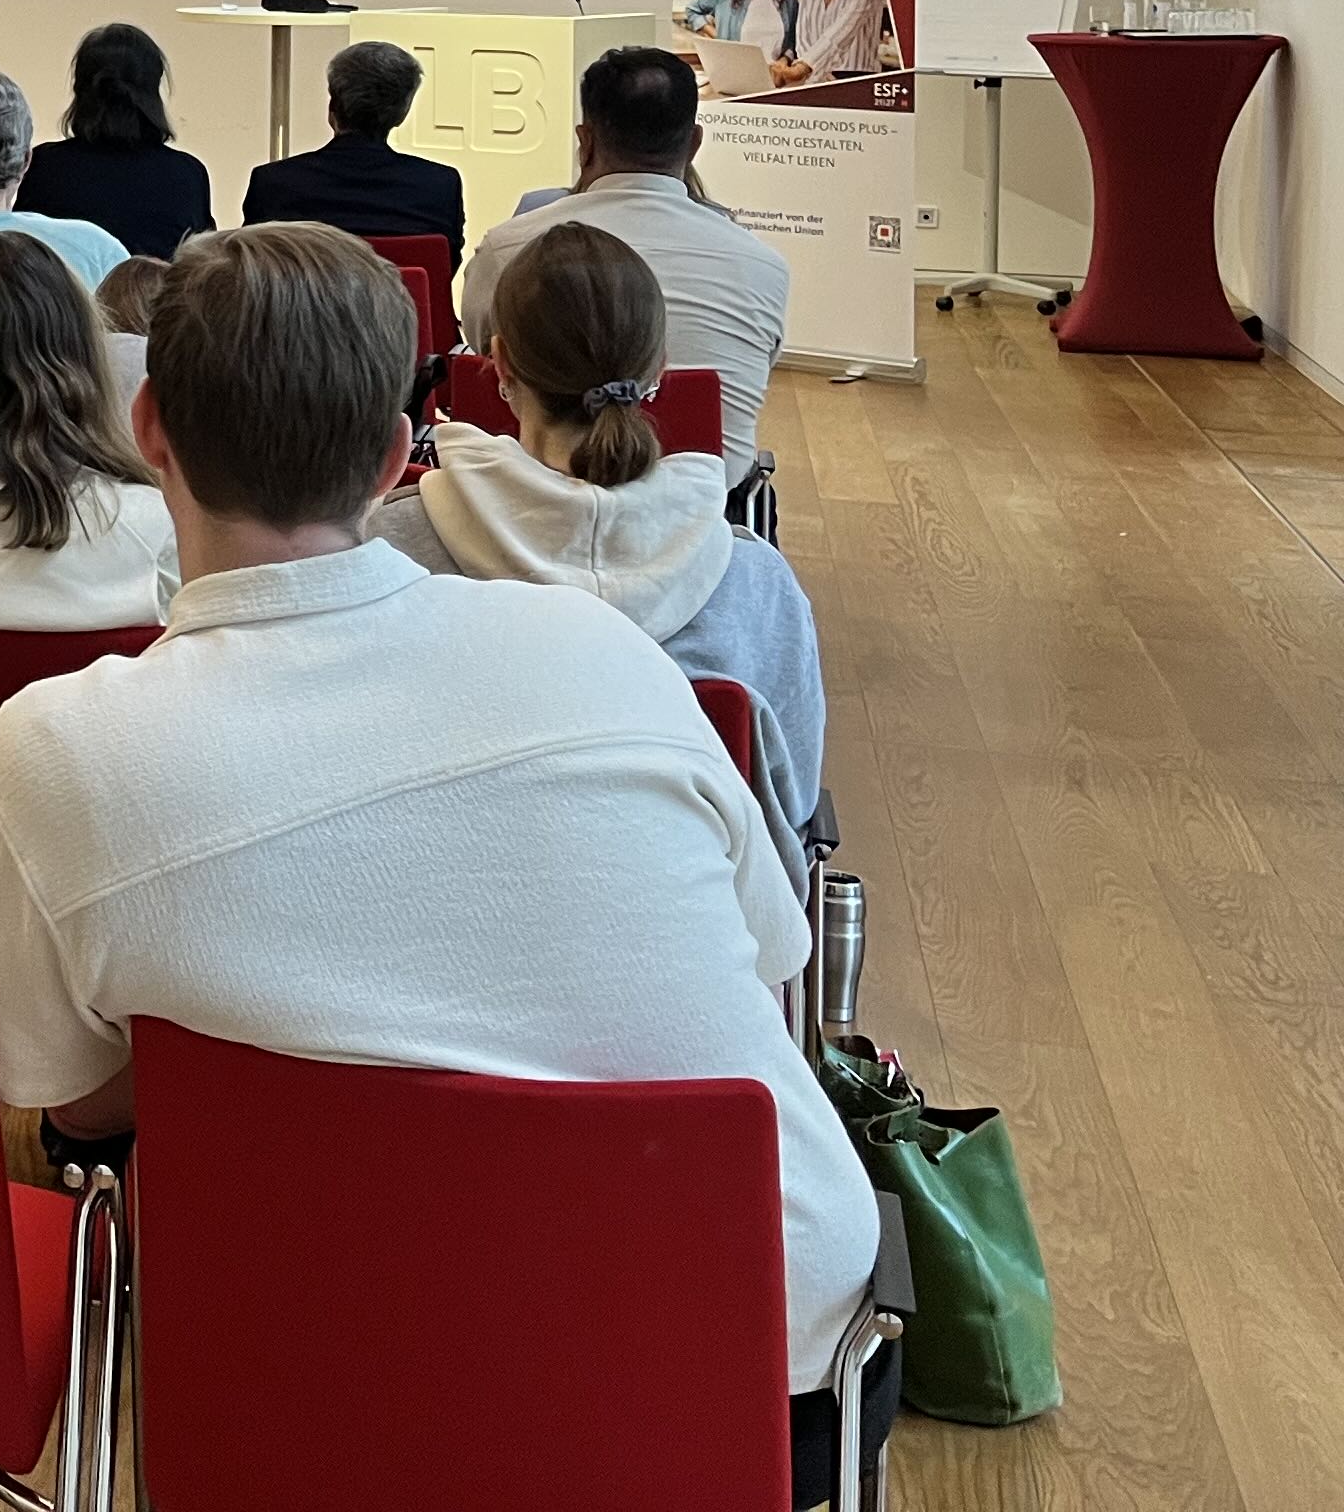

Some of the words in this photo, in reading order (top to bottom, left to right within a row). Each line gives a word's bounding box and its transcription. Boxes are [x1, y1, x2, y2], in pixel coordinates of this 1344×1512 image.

[412, 46, 548, 155] LB
[697, 113, 769, 127] ROPÄISCHER
[772, 118, 855, 133] SOZIALFONDS
[859, 124, 887, 135] PLUS
[712, 132, 790, 147] INTEGRATION
[743, 152, 792, 165] VIELFALT
[797, 155, 835, 168] LEBEN
